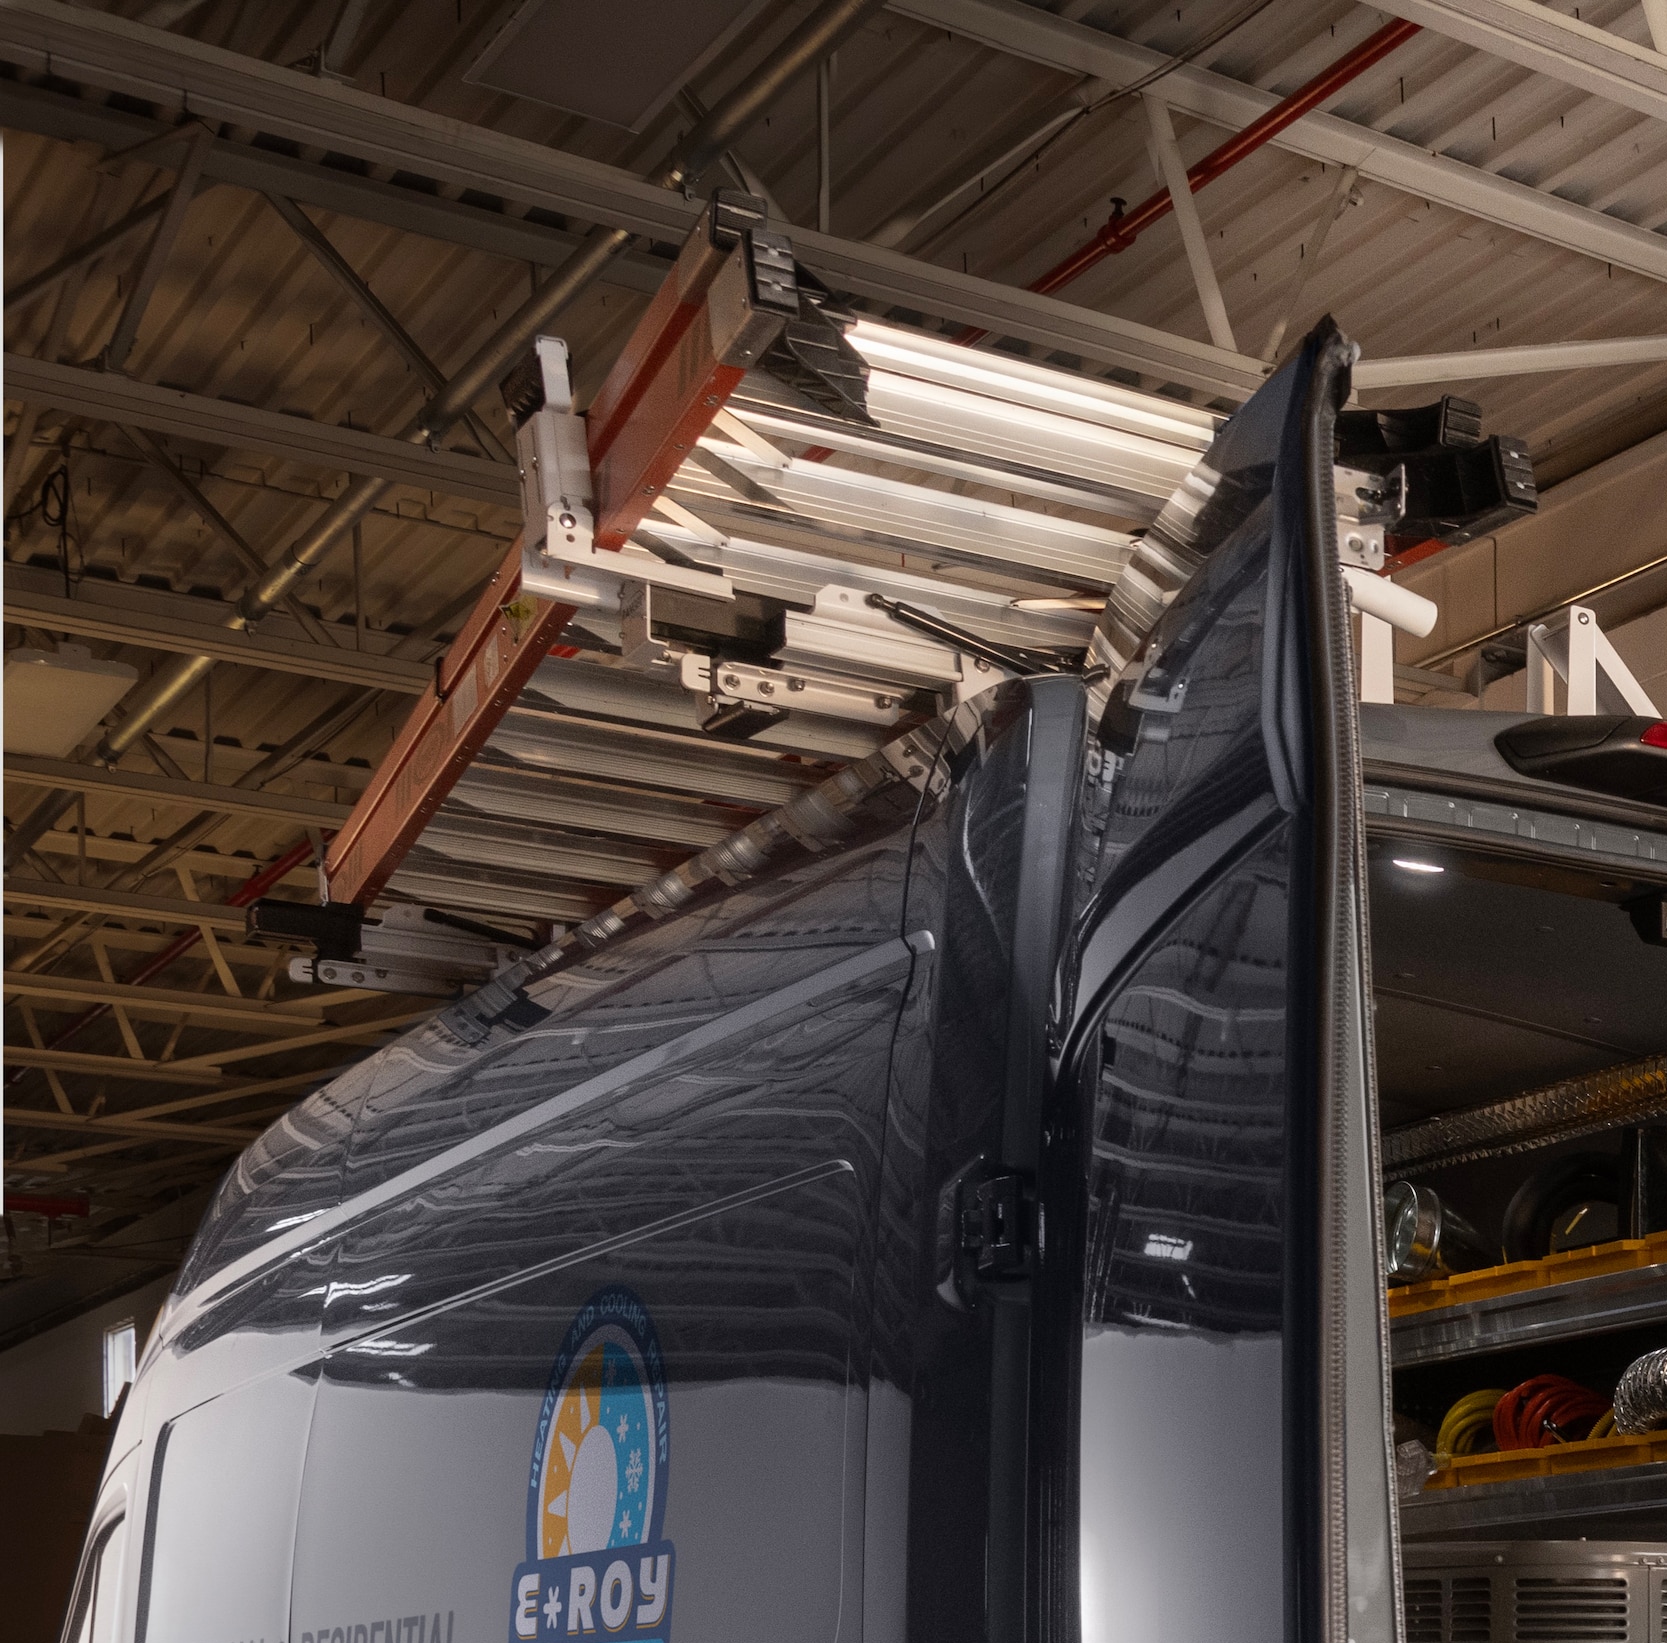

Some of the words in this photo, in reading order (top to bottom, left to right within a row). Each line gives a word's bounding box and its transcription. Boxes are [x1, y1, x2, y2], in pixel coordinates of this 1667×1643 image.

[530, 1353, 567, 1488] HEATING
[570, 1306, 595, 1349] AND
[600, 1293, 647, 1337] COOLING
[647, 1339, 668, 1465] REPAIR
